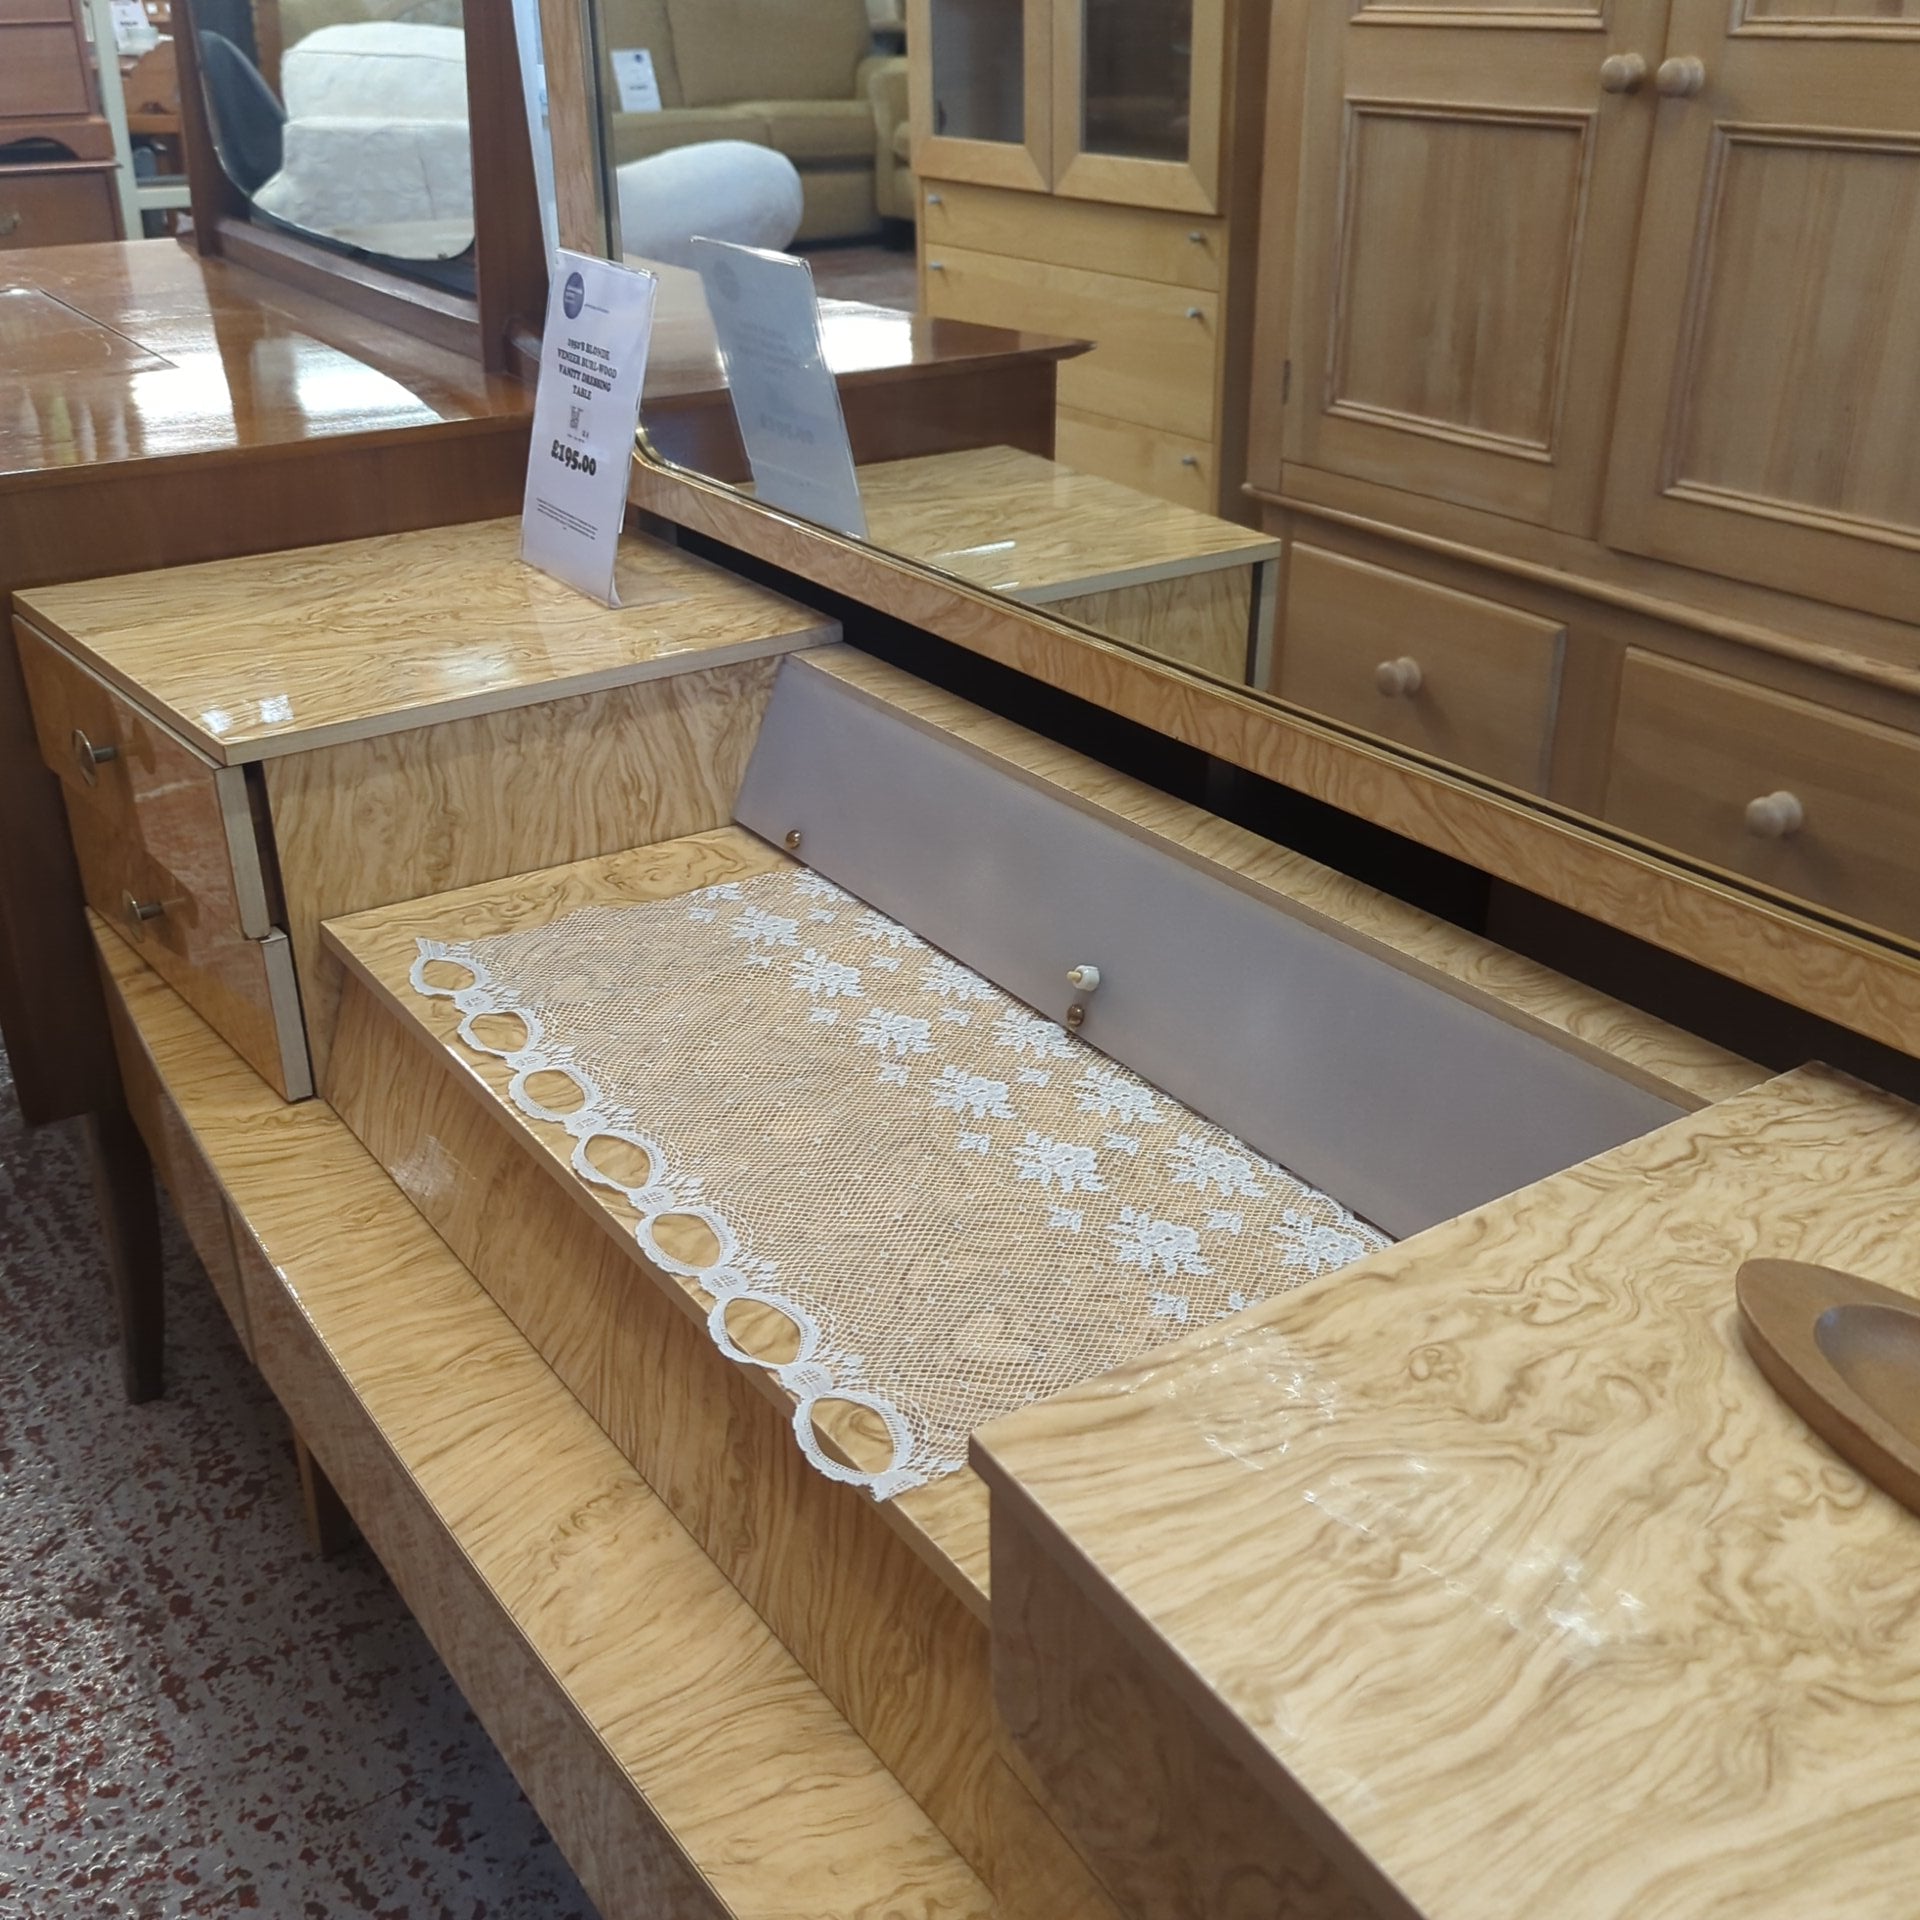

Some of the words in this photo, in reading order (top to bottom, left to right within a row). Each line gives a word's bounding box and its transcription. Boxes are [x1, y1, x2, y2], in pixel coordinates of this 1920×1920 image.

[557, 348, 581, 365] VENEER
[559, 364, 581, 381] VANITY
[581, 372, 611, 392] DRESSING
[572, 385, 592, 400] TABLE
[551, 439, 597, 476] £195.00
